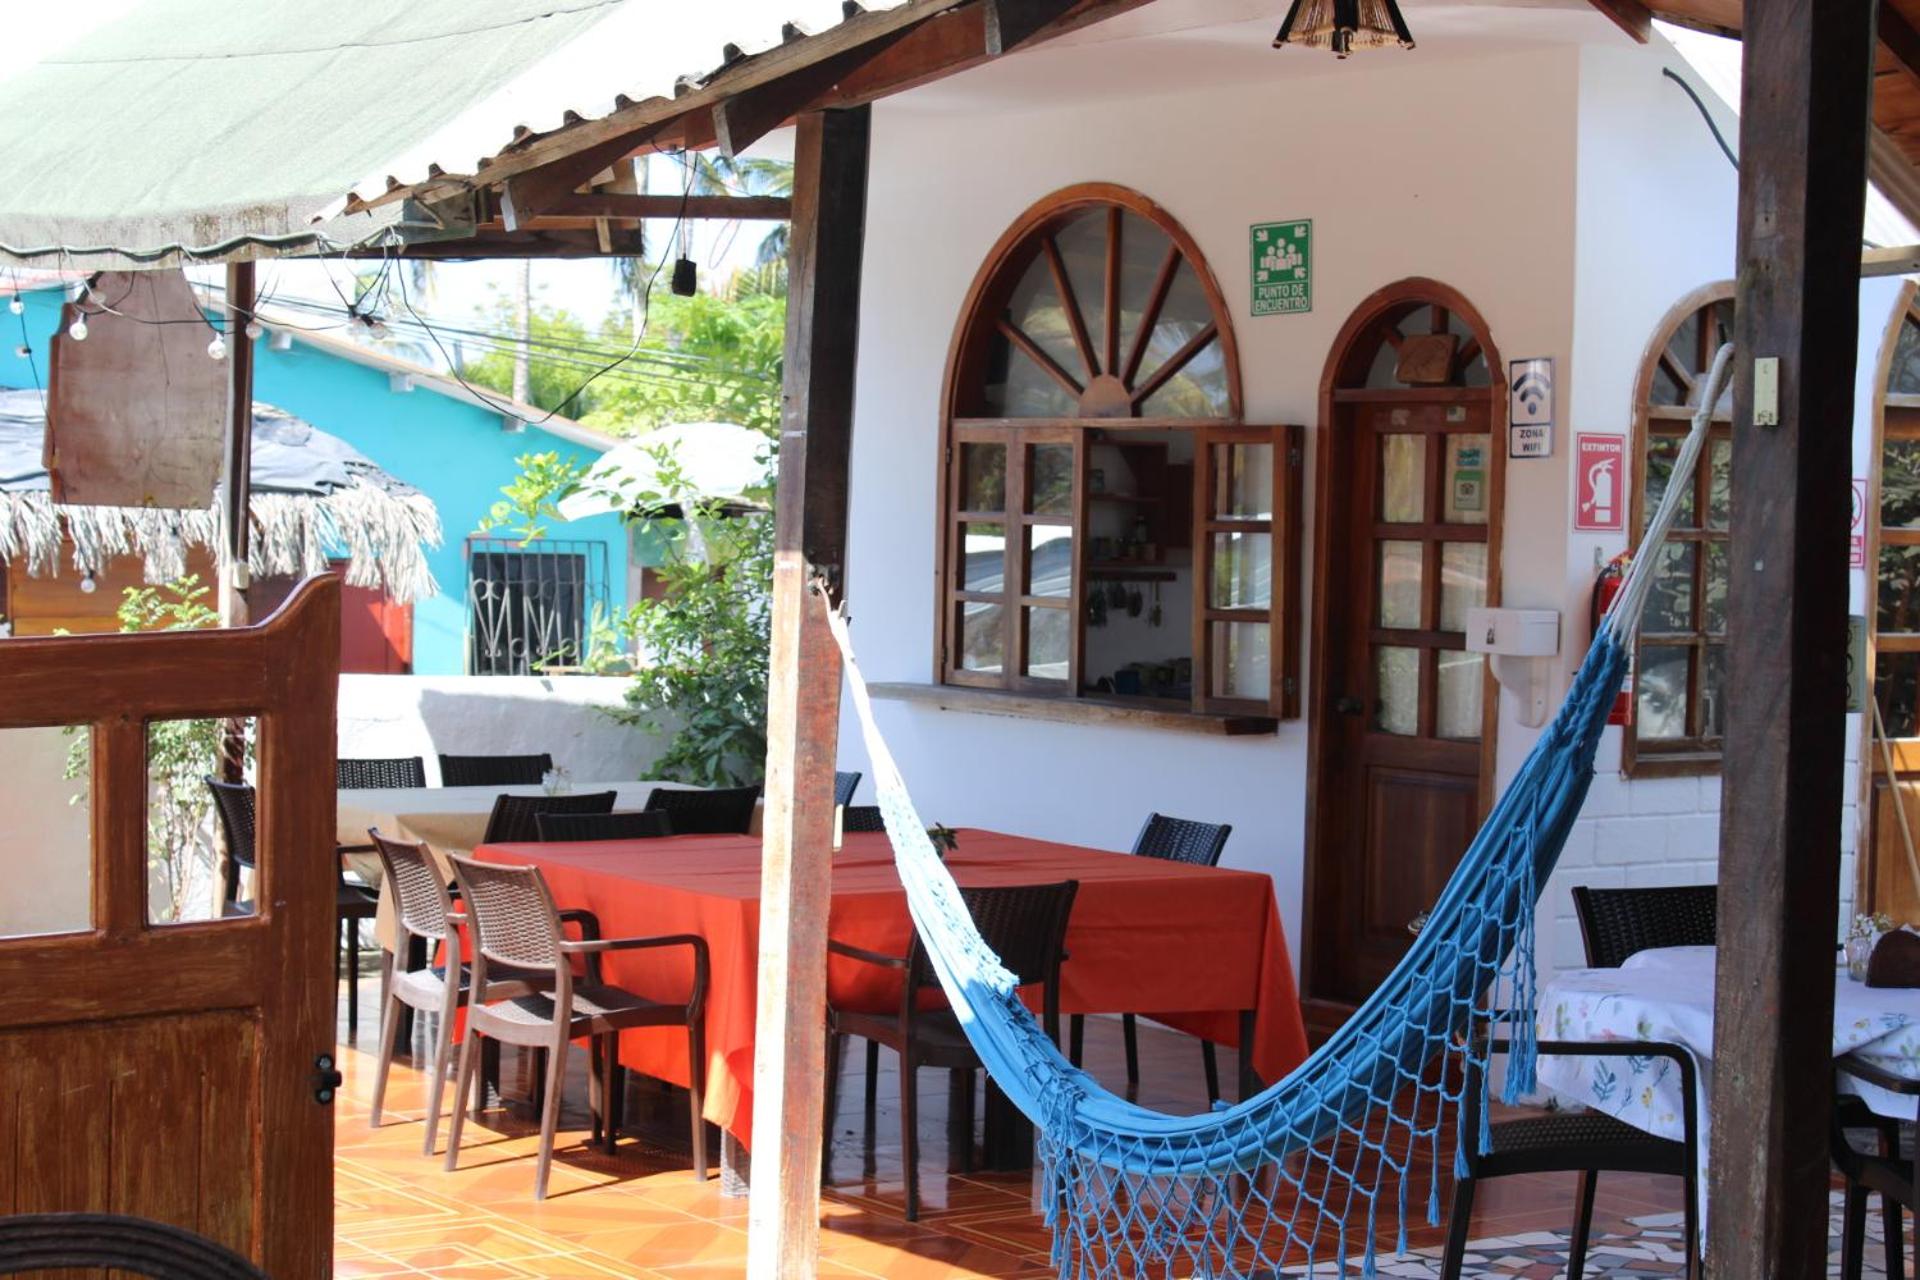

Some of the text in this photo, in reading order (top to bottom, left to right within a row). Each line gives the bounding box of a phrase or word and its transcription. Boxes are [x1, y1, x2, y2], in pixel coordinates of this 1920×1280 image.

[1259, 283, 1304, 298] PUNTO DE
[1255, 296, 1308, 311] ENCUENTRO
[1520, 429, 1543, 438] ZONA
[1522, 442, 1541, 451] WIFI
[1581, 442, 1621, 453] EXTINTOR
